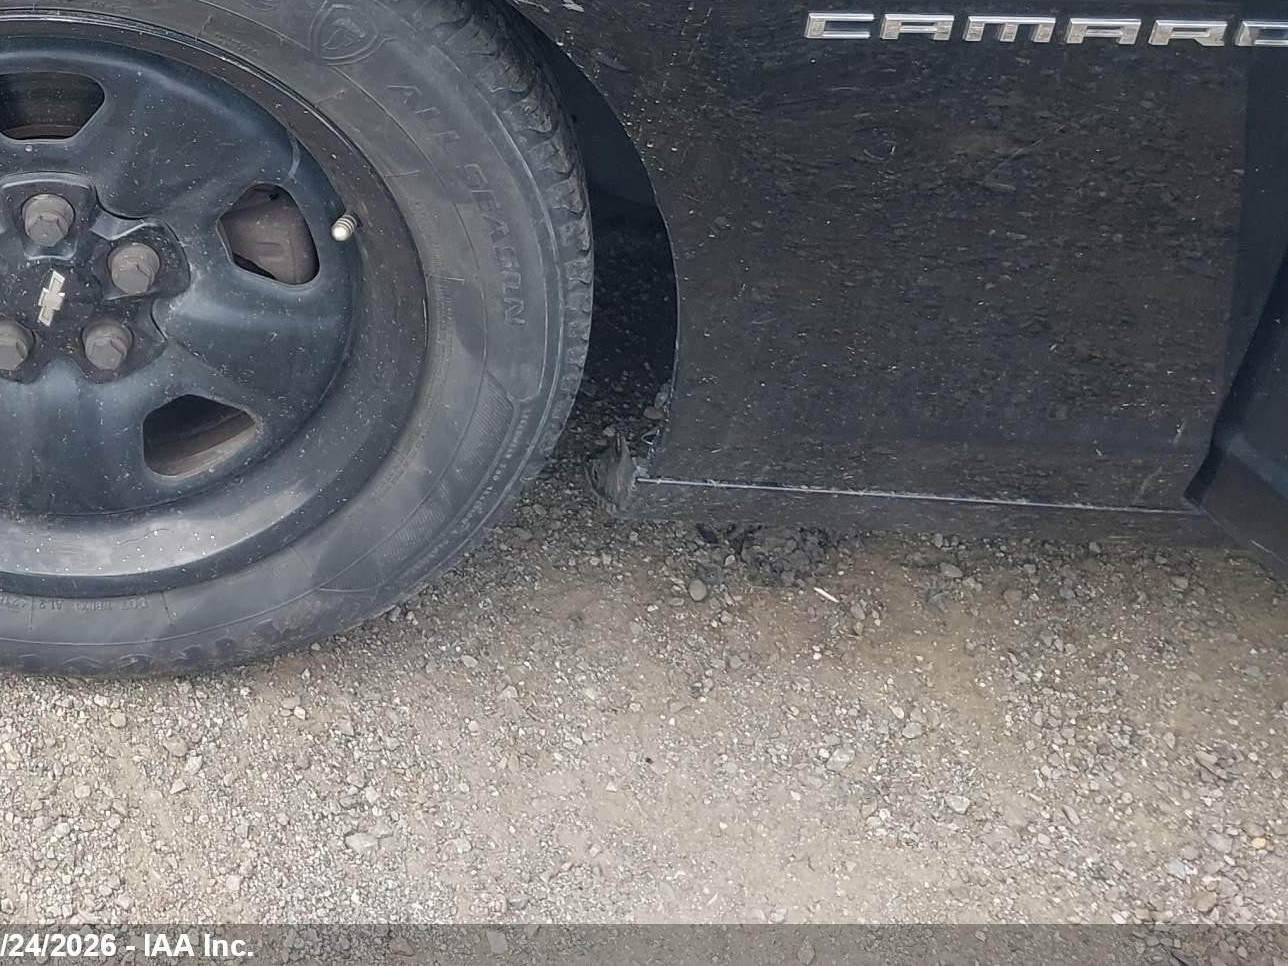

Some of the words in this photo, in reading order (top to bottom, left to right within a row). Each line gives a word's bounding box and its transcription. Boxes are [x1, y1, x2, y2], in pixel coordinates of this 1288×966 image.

[804, 12, 1288, 47] CAMARO
[384, 83, 462, 156] ALL
[461, 162, 528, 326] SEASON
